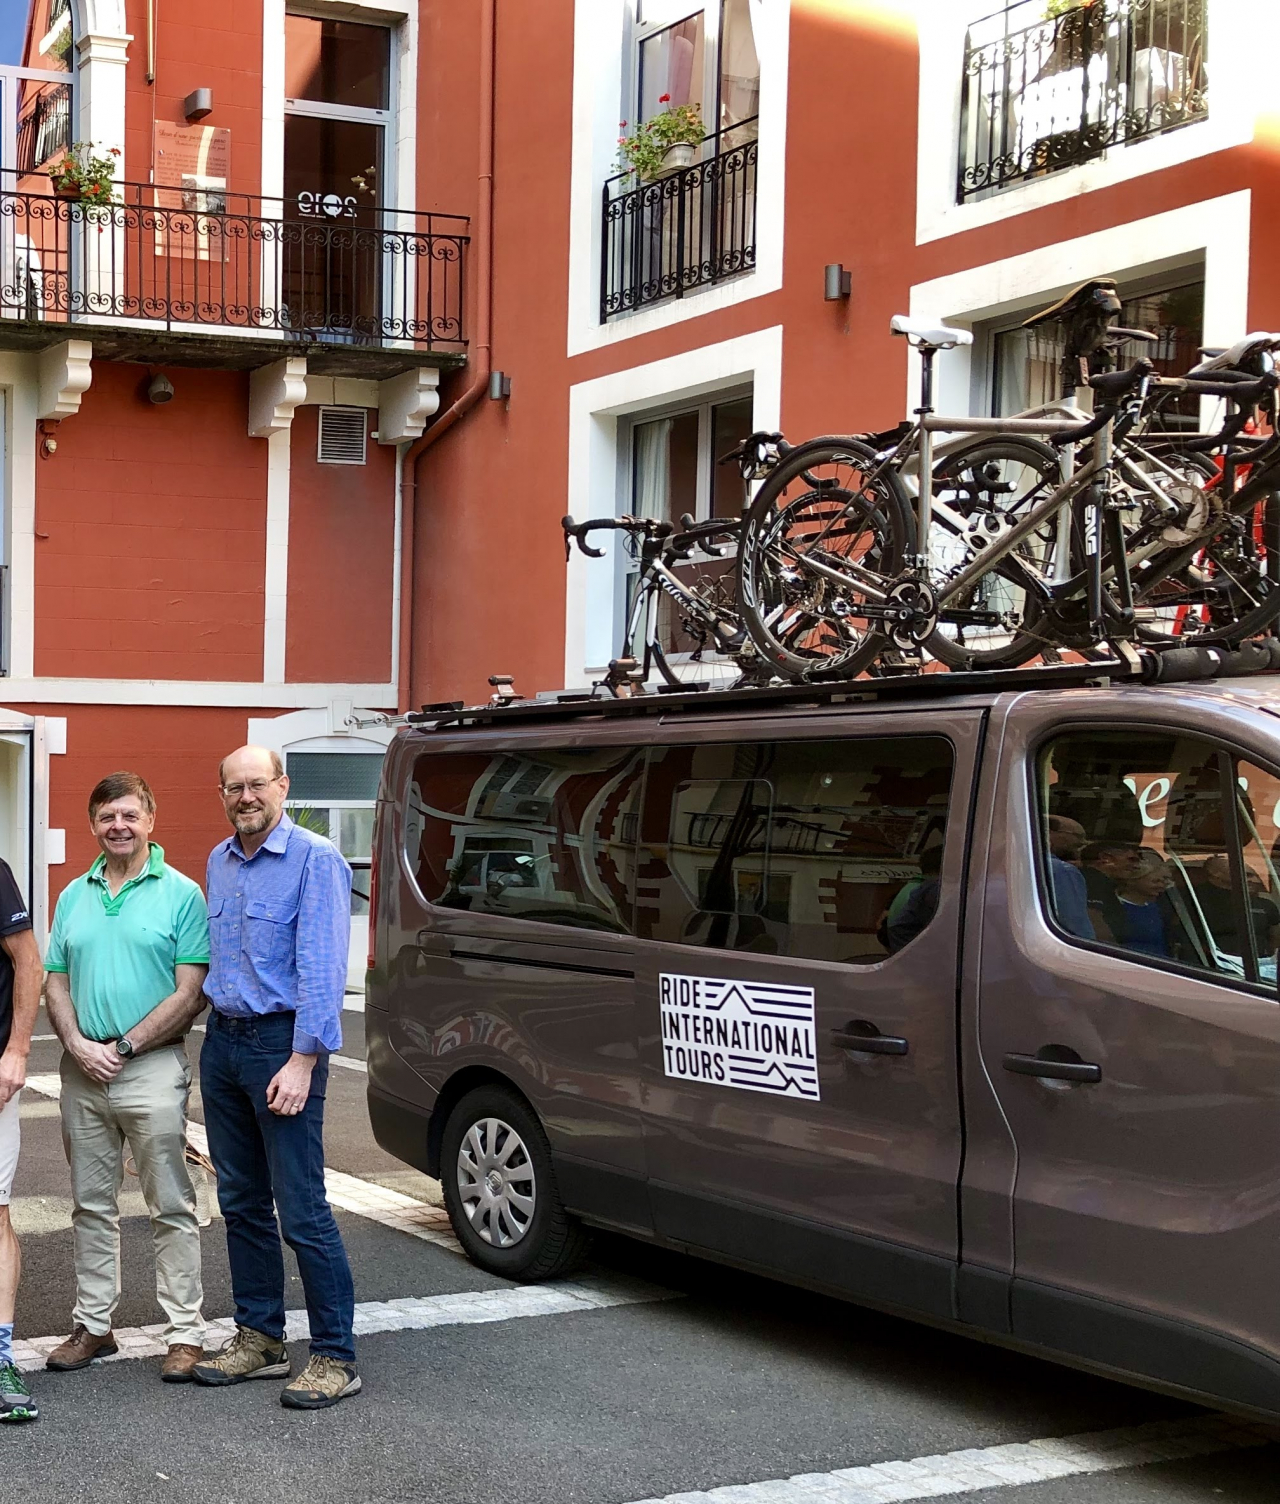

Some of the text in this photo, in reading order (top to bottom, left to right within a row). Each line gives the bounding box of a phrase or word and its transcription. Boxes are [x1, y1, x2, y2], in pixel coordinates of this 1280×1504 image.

[661, 977, 701, 1008] RIDE
[662, 1011, 814, 1059] INTERNATIONAL
[665, 1045, 725, 1081] TOURS
